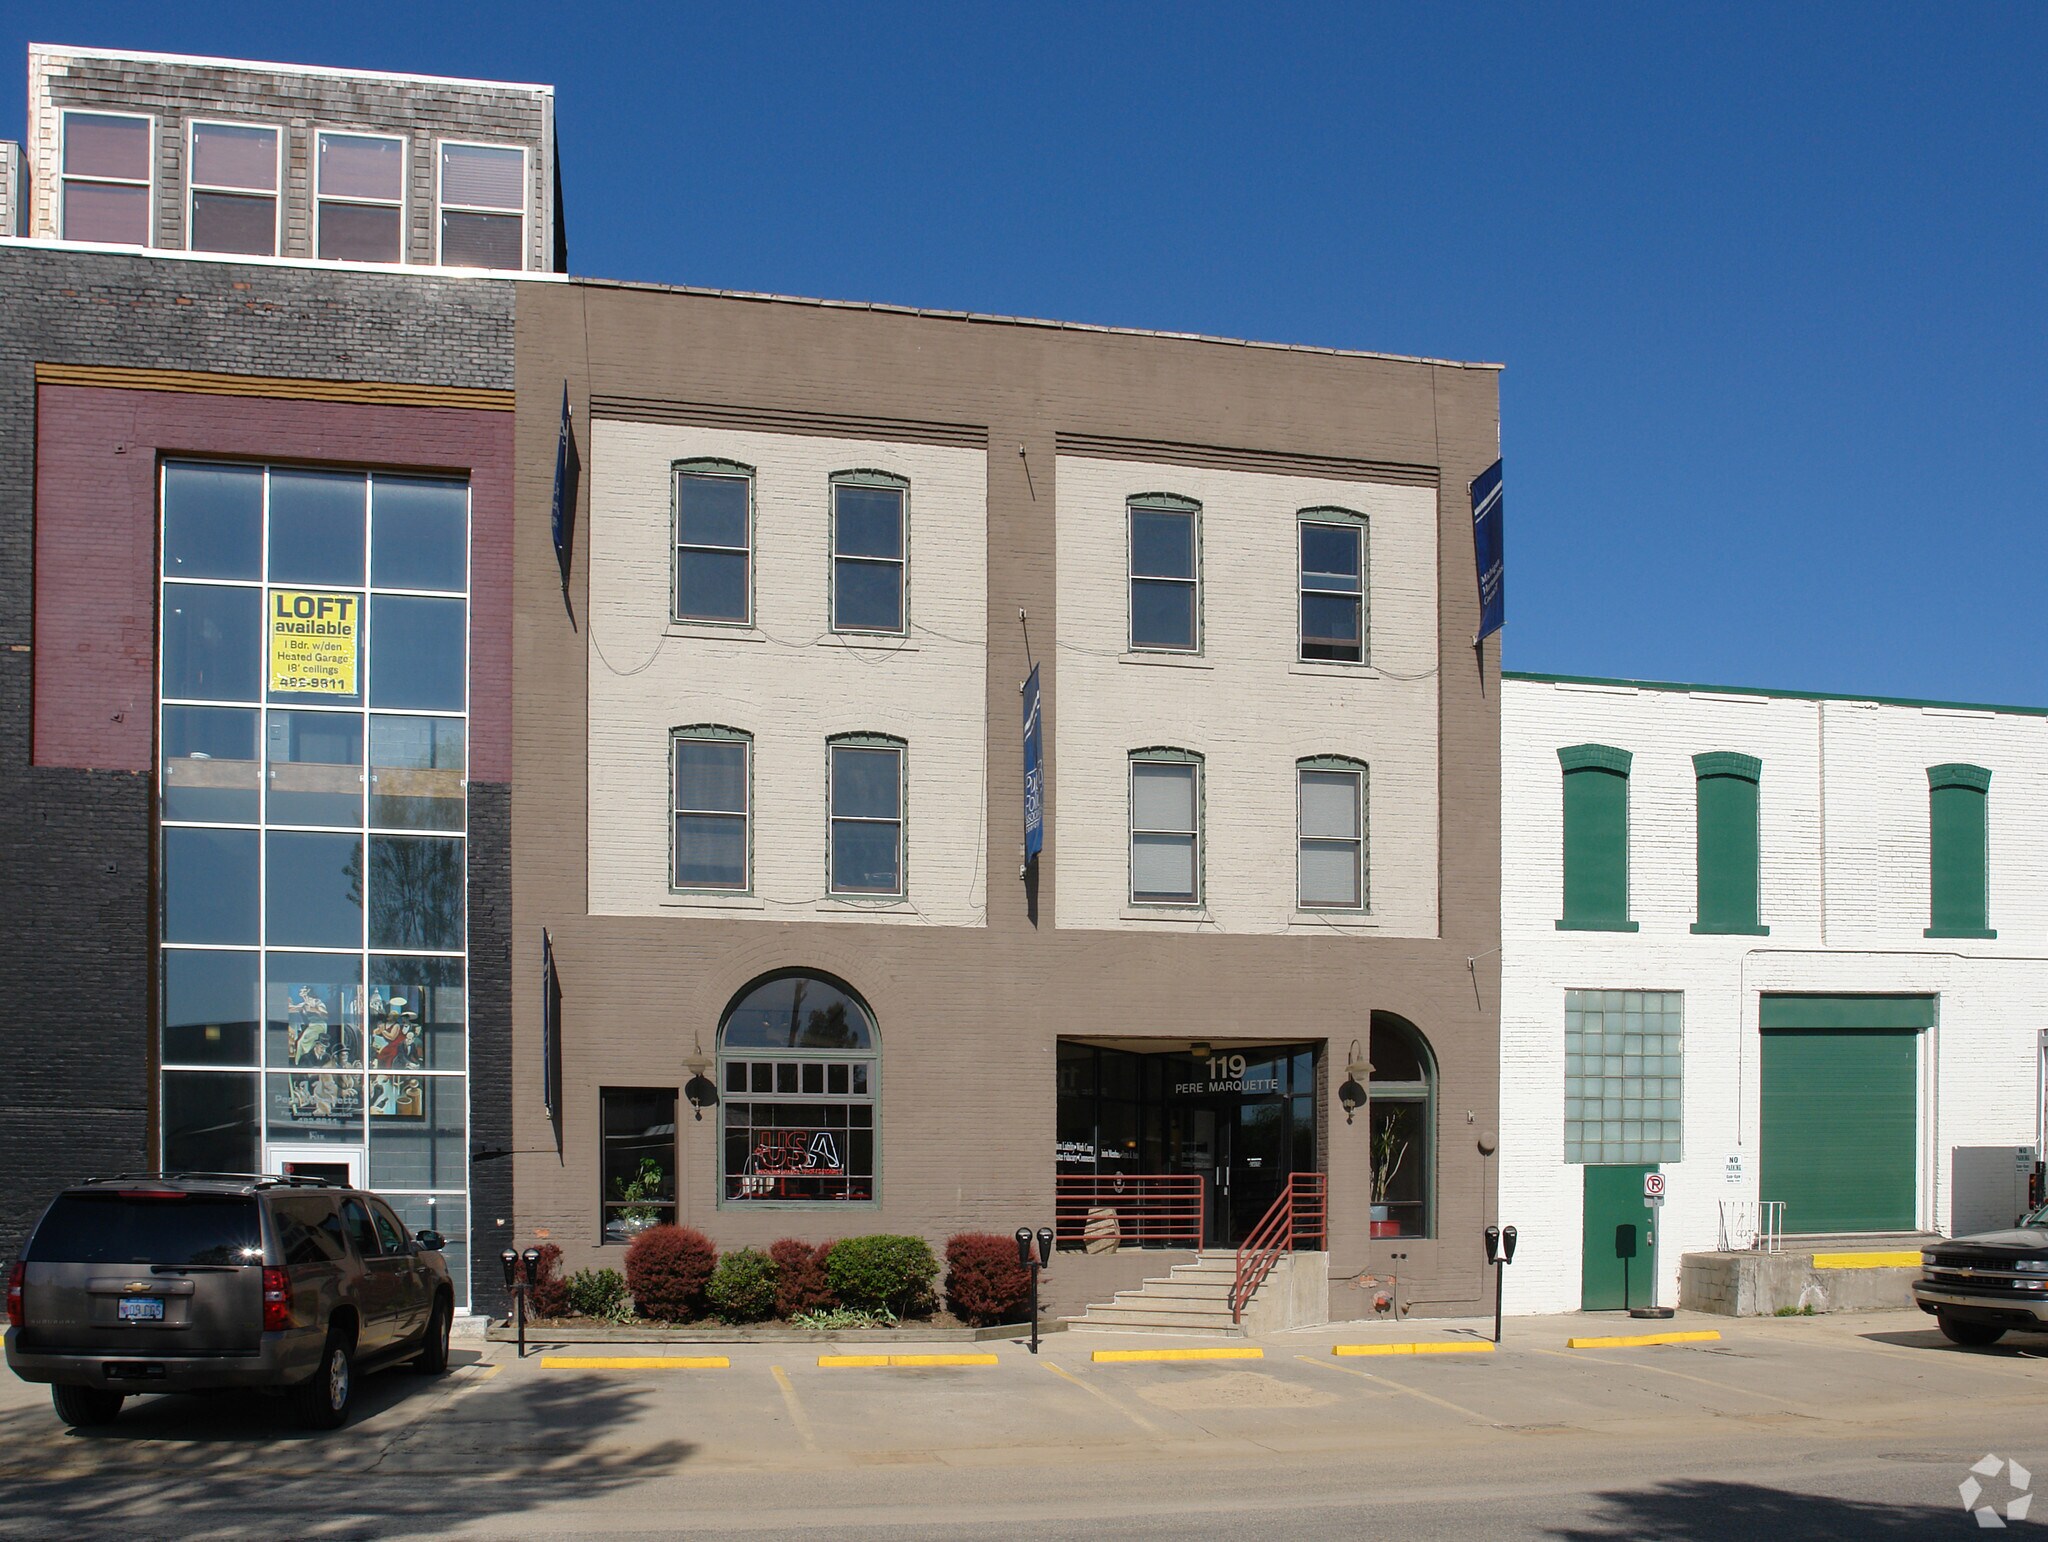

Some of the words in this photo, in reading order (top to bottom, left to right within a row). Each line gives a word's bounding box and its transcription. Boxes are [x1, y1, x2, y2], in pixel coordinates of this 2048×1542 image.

[277, 595, 353, 620] LOFT
[275, 620, 352, 635] available
[290, 640, 310, 650] Bdr.
[312, 641, 342, 652] w/den
[277, 651, 313, 661] Heated
[314, 653, 348, 664] Garage
[303, 665, 339, 676] ceilings
[1205, 1054, 1247, 1080] 119
[1175, 1082, 1203, 1094] PERE
[1208, 1078, 1278, 1093] MARQUETTE
[761, 1131, 839, 1167] USA
